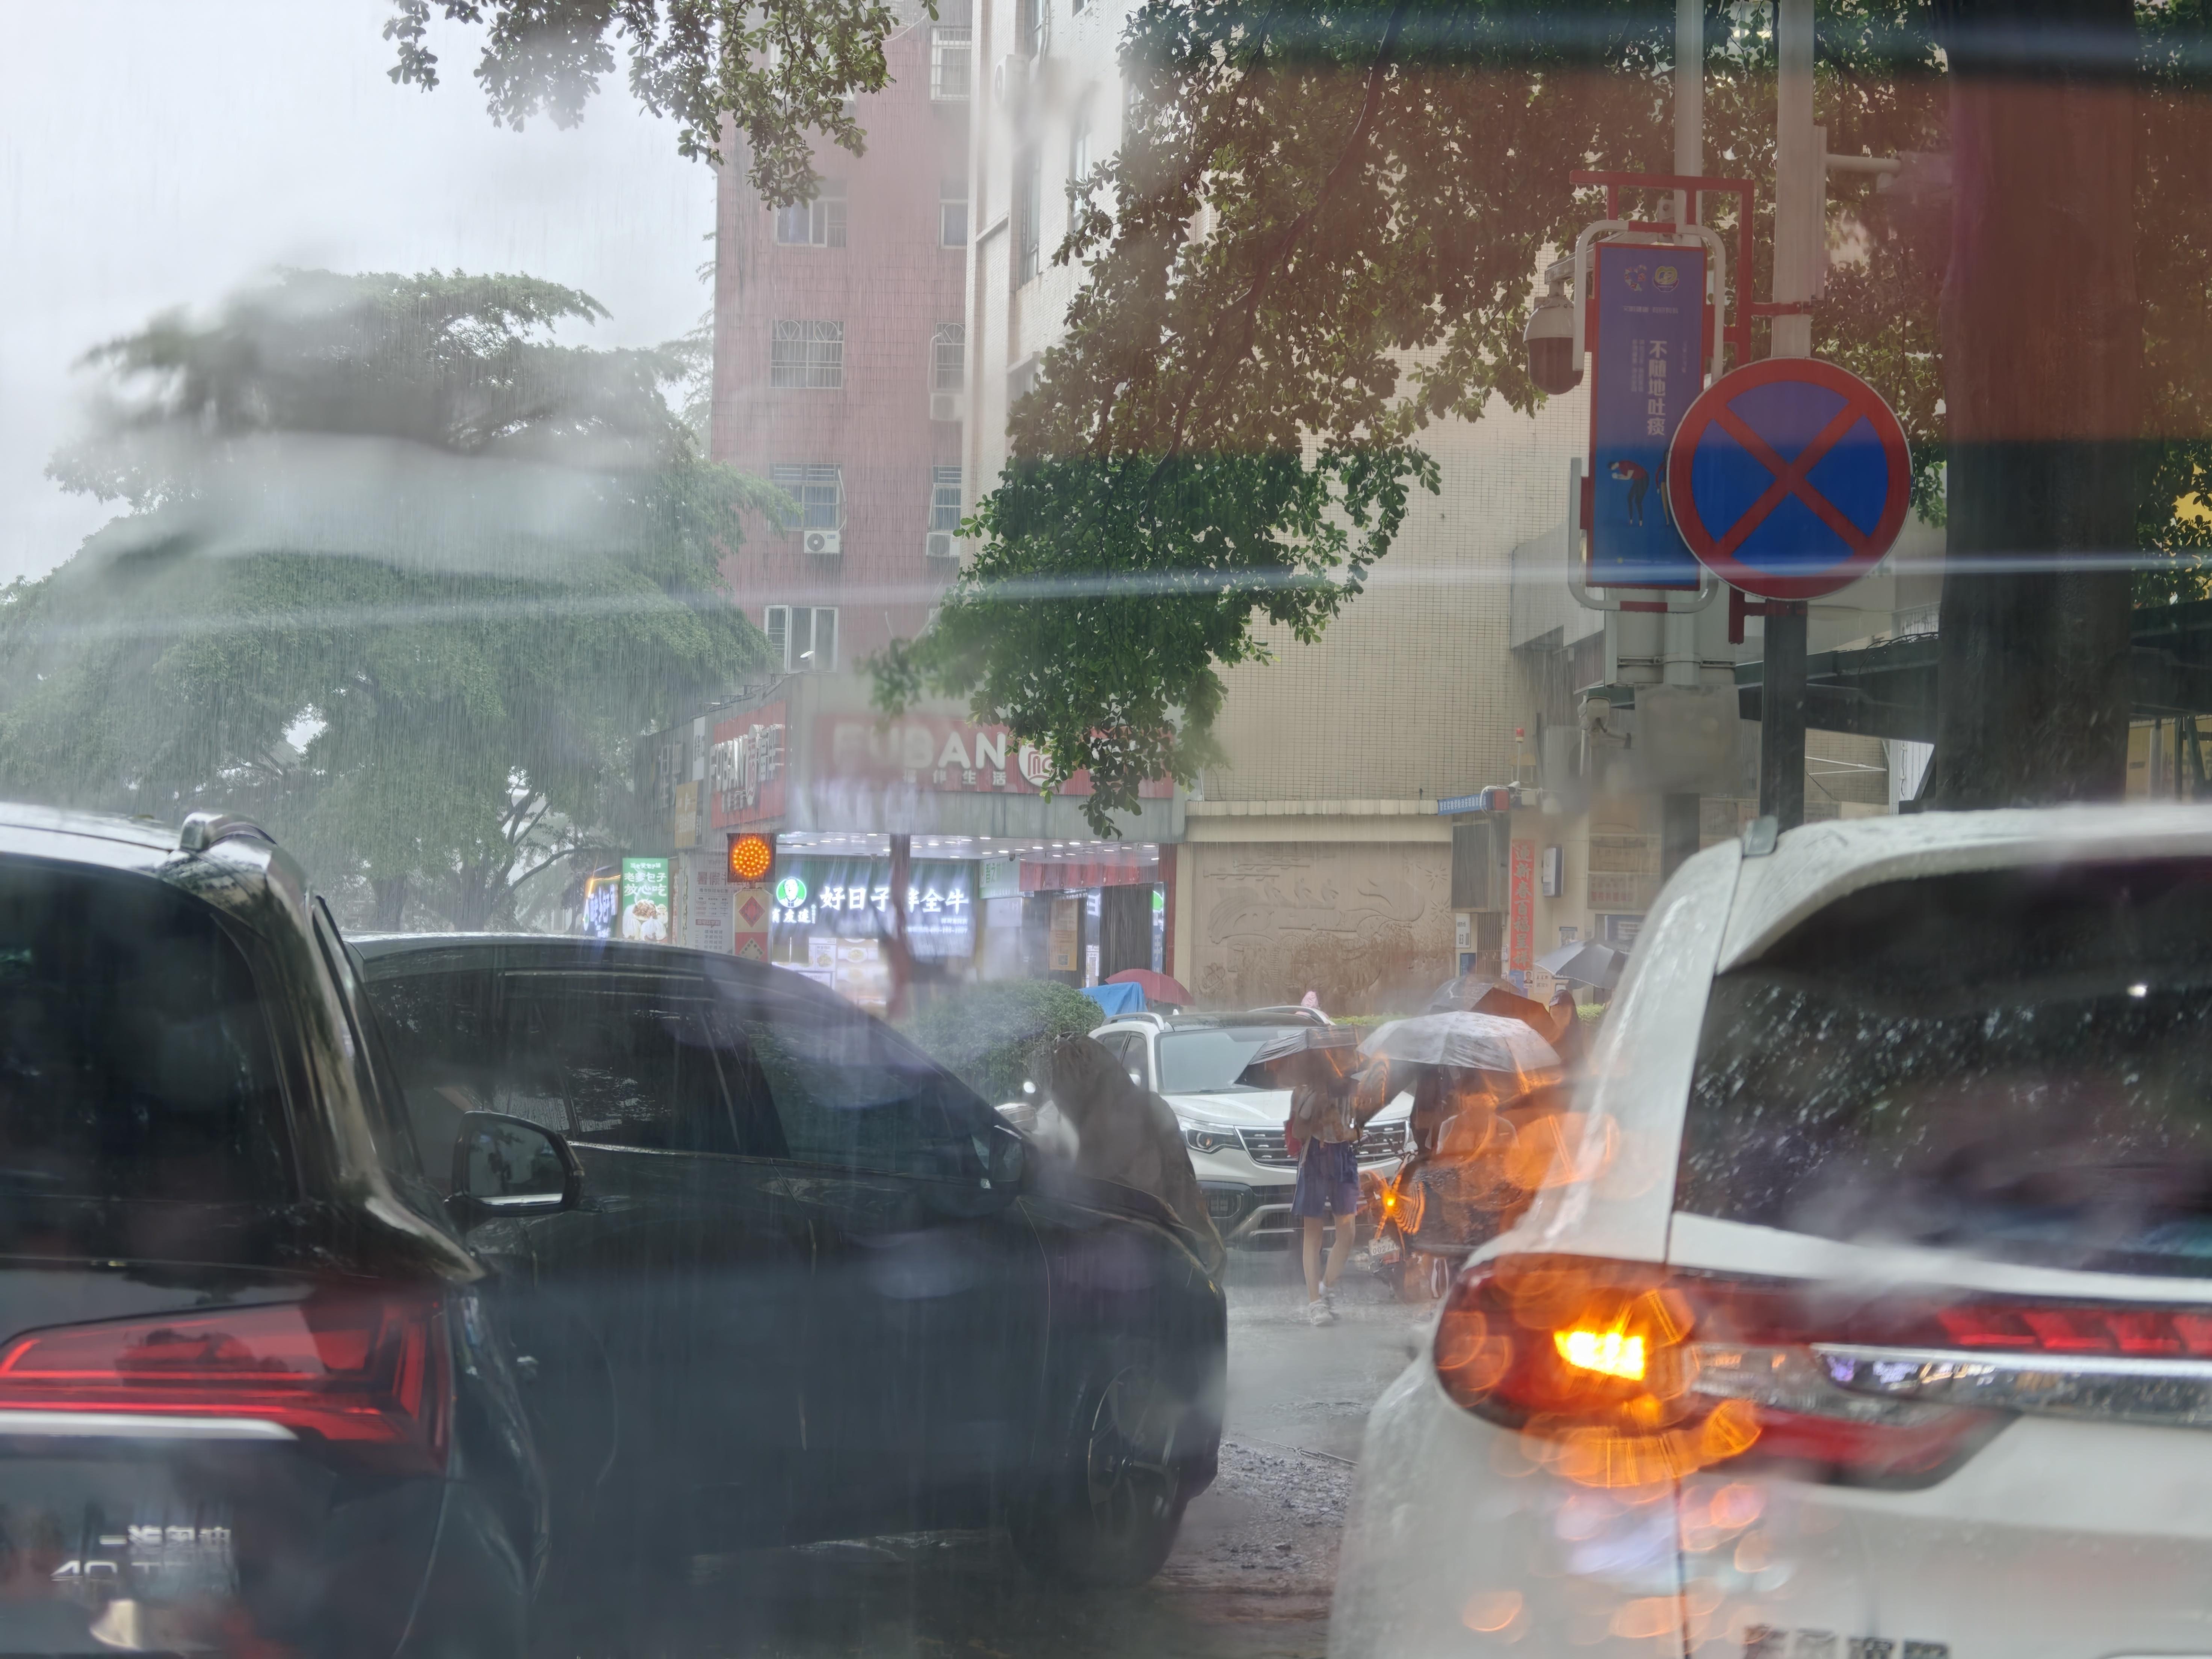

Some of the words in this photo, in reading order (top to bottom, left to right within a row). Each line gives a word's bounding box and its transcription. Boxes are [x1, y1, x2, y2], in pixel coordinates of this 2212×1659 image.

[1647, 340, 1667, 435] 不随地吐痰
[709, 734, 748, 795] FUBAN
[833, 724, 1006, 770] FUBAN
[624, 883, 667, 897] 放心吃
